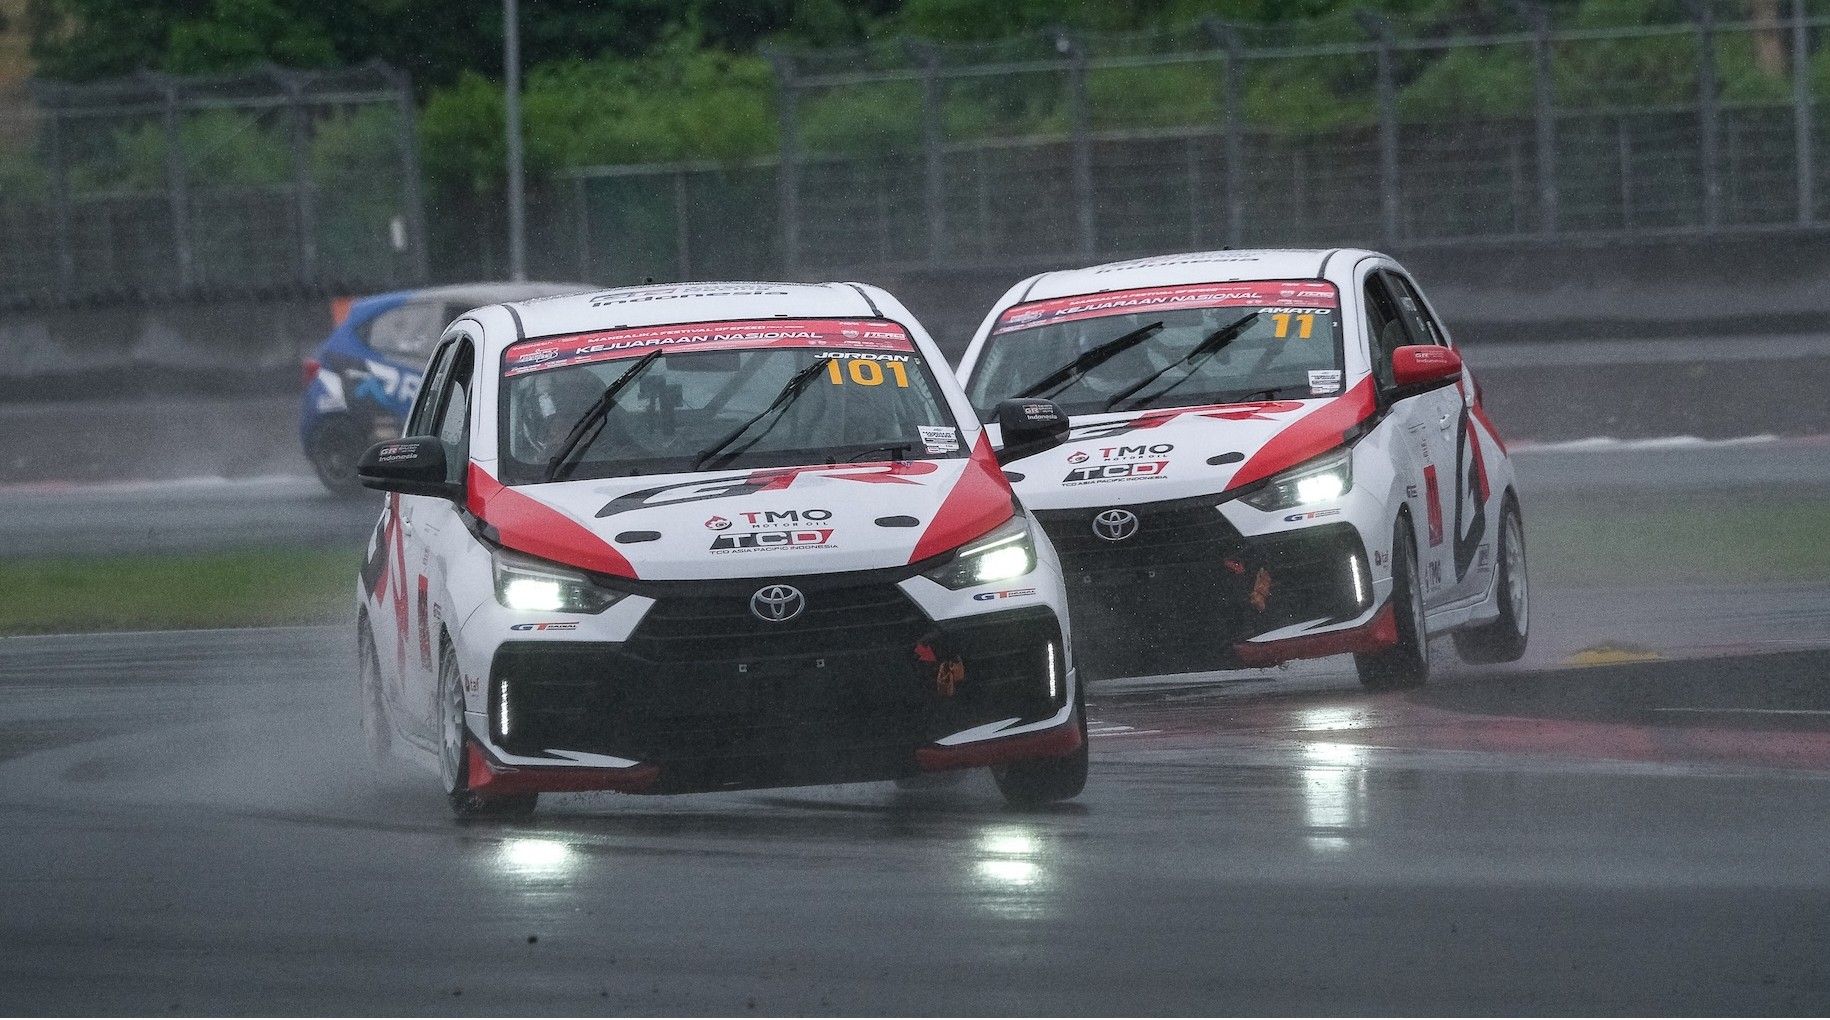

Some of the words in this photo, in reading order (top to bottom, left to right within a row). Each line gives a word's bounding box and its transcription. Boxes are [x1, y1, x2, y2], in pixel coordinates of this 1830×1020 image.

[1055, 297, 1166, 316] KEJUARAAN
[1173, 292, 1263, 302] NASIONAL
[1272, 313, 1313, 338] 11
[575, 335, 708, 354] KEJUARAAN
[714, 332, 823, 341] NASIONAL
[588, 332, 658, 343] MANDALIKA
[661, 328, 713, 336] FESTIVAL
[814, 352, 909, 362] JORDAN
[827, 358, 909, 388] 101
[1099, 443, 1174, 458] TMO
[1073, 462, 1160, 480] TCD
[740, 509, 833, 524] TMO
[719, 530, 824, 548] TCD
